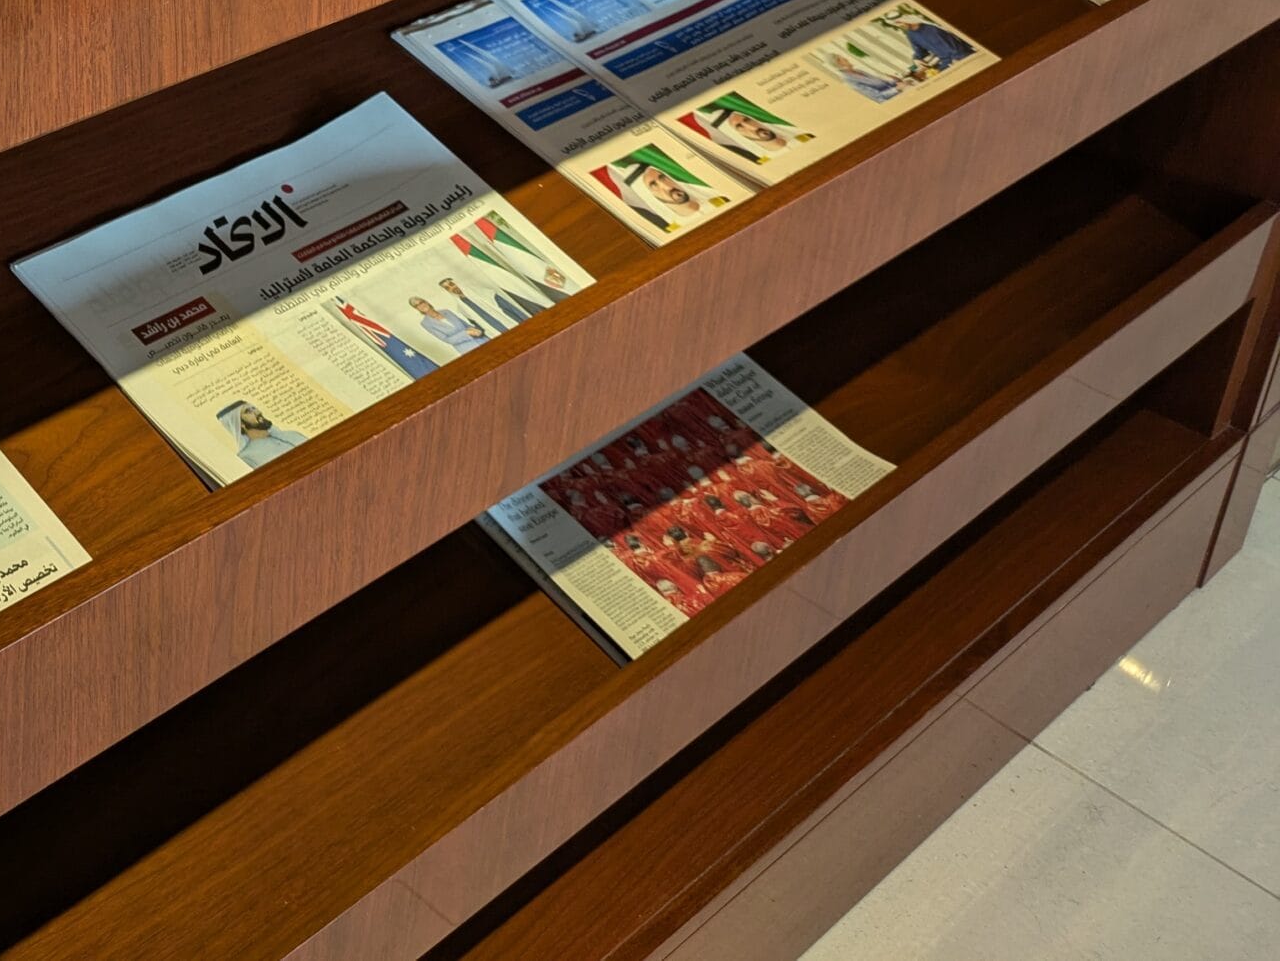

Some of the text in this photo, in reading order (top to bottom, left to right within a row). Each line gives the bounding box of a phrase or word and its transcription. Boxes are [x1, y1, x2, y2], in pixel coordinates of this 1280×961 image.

[440, 184, 474, 211] رئيس
[402, 203, 446, 229] الدولة
[350, 225, 410, 257] والحاكمة
[312, 248, 355, 274] العامة
[141, 303, 208, 339] محمد بن راشد
[0, 559, 28, 579] محمد
[18, 563, 58, 593] تخصيص
